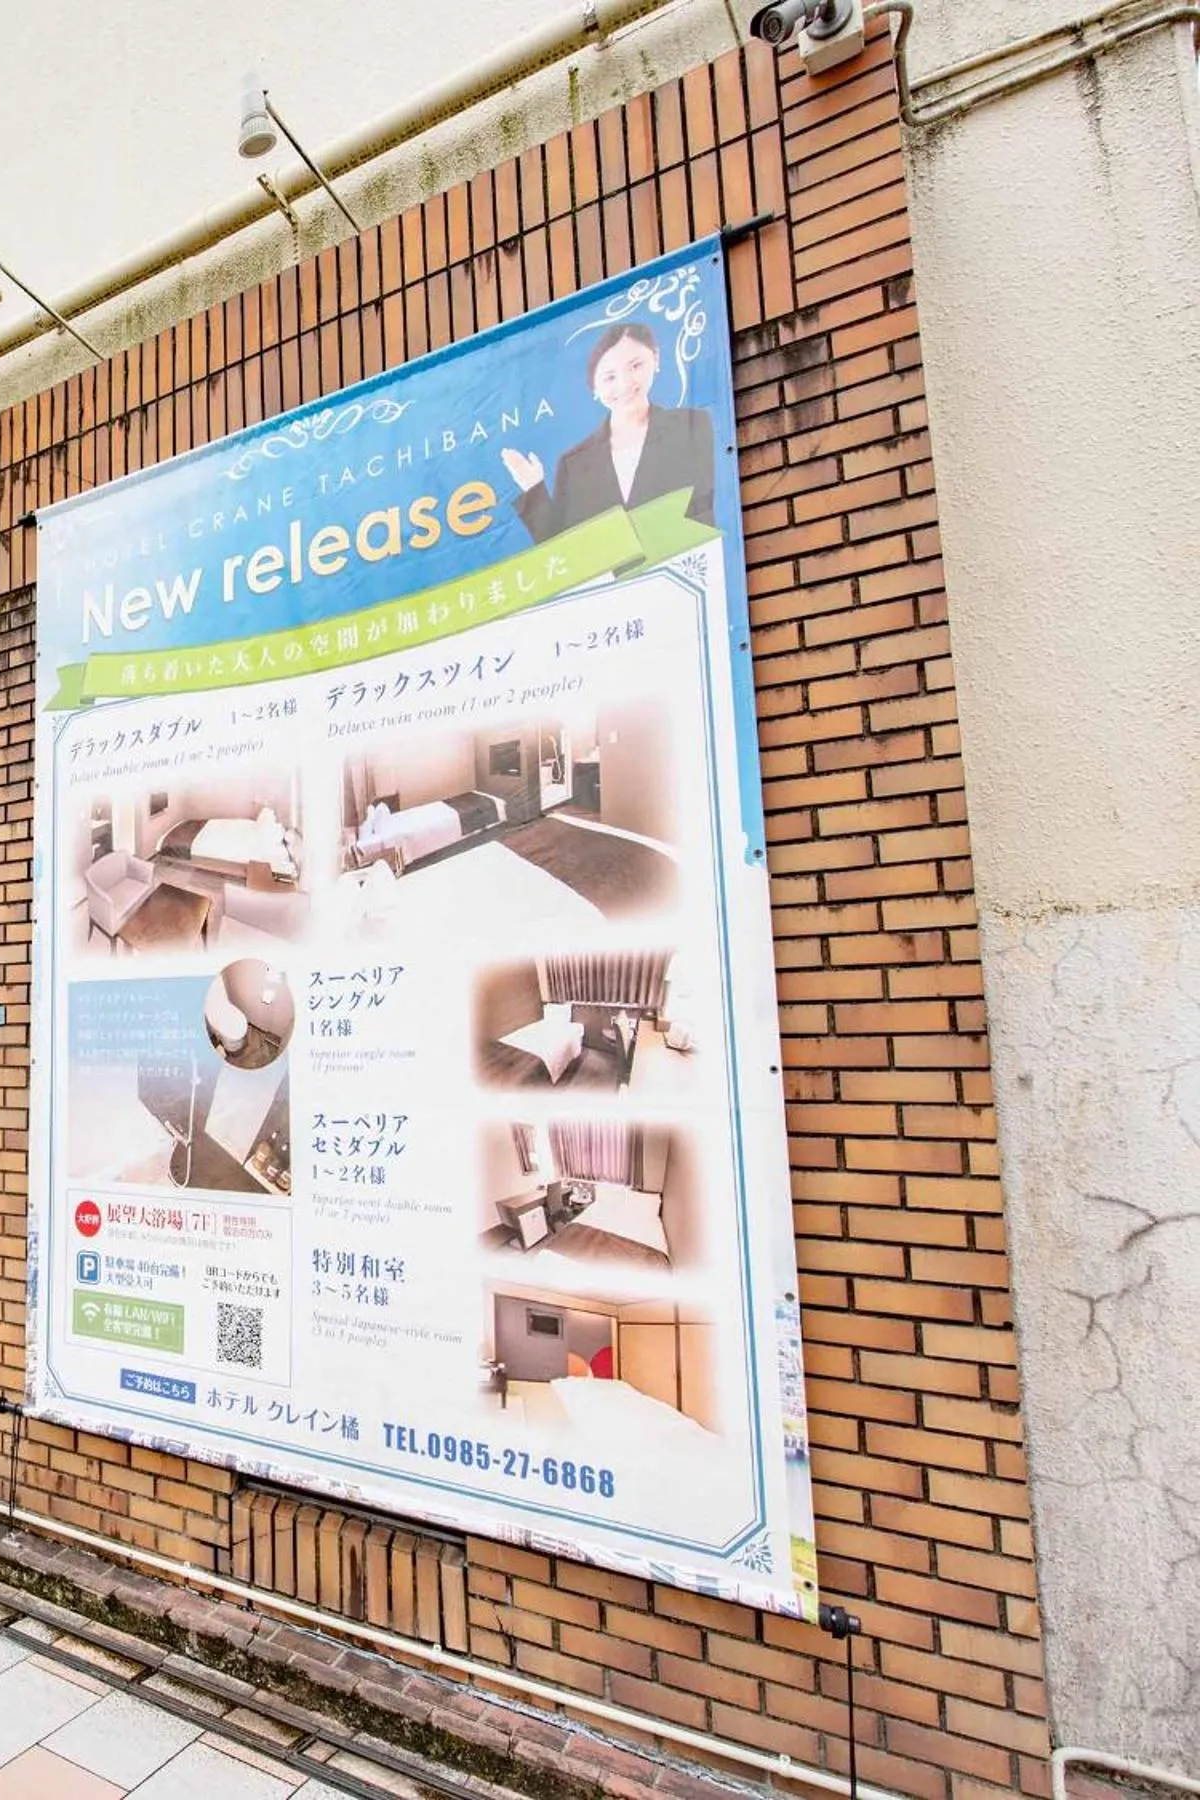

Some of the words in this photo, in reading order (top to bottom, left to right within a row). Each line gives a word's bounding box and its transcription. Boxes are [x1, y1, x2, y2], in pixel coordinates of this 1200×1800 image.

[84, 532, 167, 571] HOTEL
[188, 486, 294, 538] CRANE
[319, 398, 555, 494] TACHIBANA
[81, 567, 202, 644] New
[223, 481, 497, 603] release
[121, 554, 569, 685] 落ち着いた大人の空間が加わりました
[326, 650, 516, 713] デラックスツイン
[327, 716, 376, 738] Deluxe
[380, 711, 412, 729] twin
[417, 704, 456, 721] room
[482, 695, 501, 710] or
[505, 688, 516, 706] 2
[519, 675, 584, 705] people)
[70, 716, 202, 763] デラックスダブル
[216, 738, 264, 761] people)
[308, 965, 405, 988] スーペリア
[308, 989, 386, 1012] シングル
[310, 1018, 353, 1038] 1名様
[312, 1113, 408, 1134] スーペリア
[311, 1136, 407, 1157] セミダブル
[84, 1256, 97, 1276] P
[312, 1248, 405, 1284] 特別和室
[123, 1373, 191, 1401] ご予約はこちら
[207, 1387, 258, 1416] ホテル
[267, 1400, 360, 1441] クレイン橘
[382, 1422, 615, 1498] TEL.0985-27-6868
